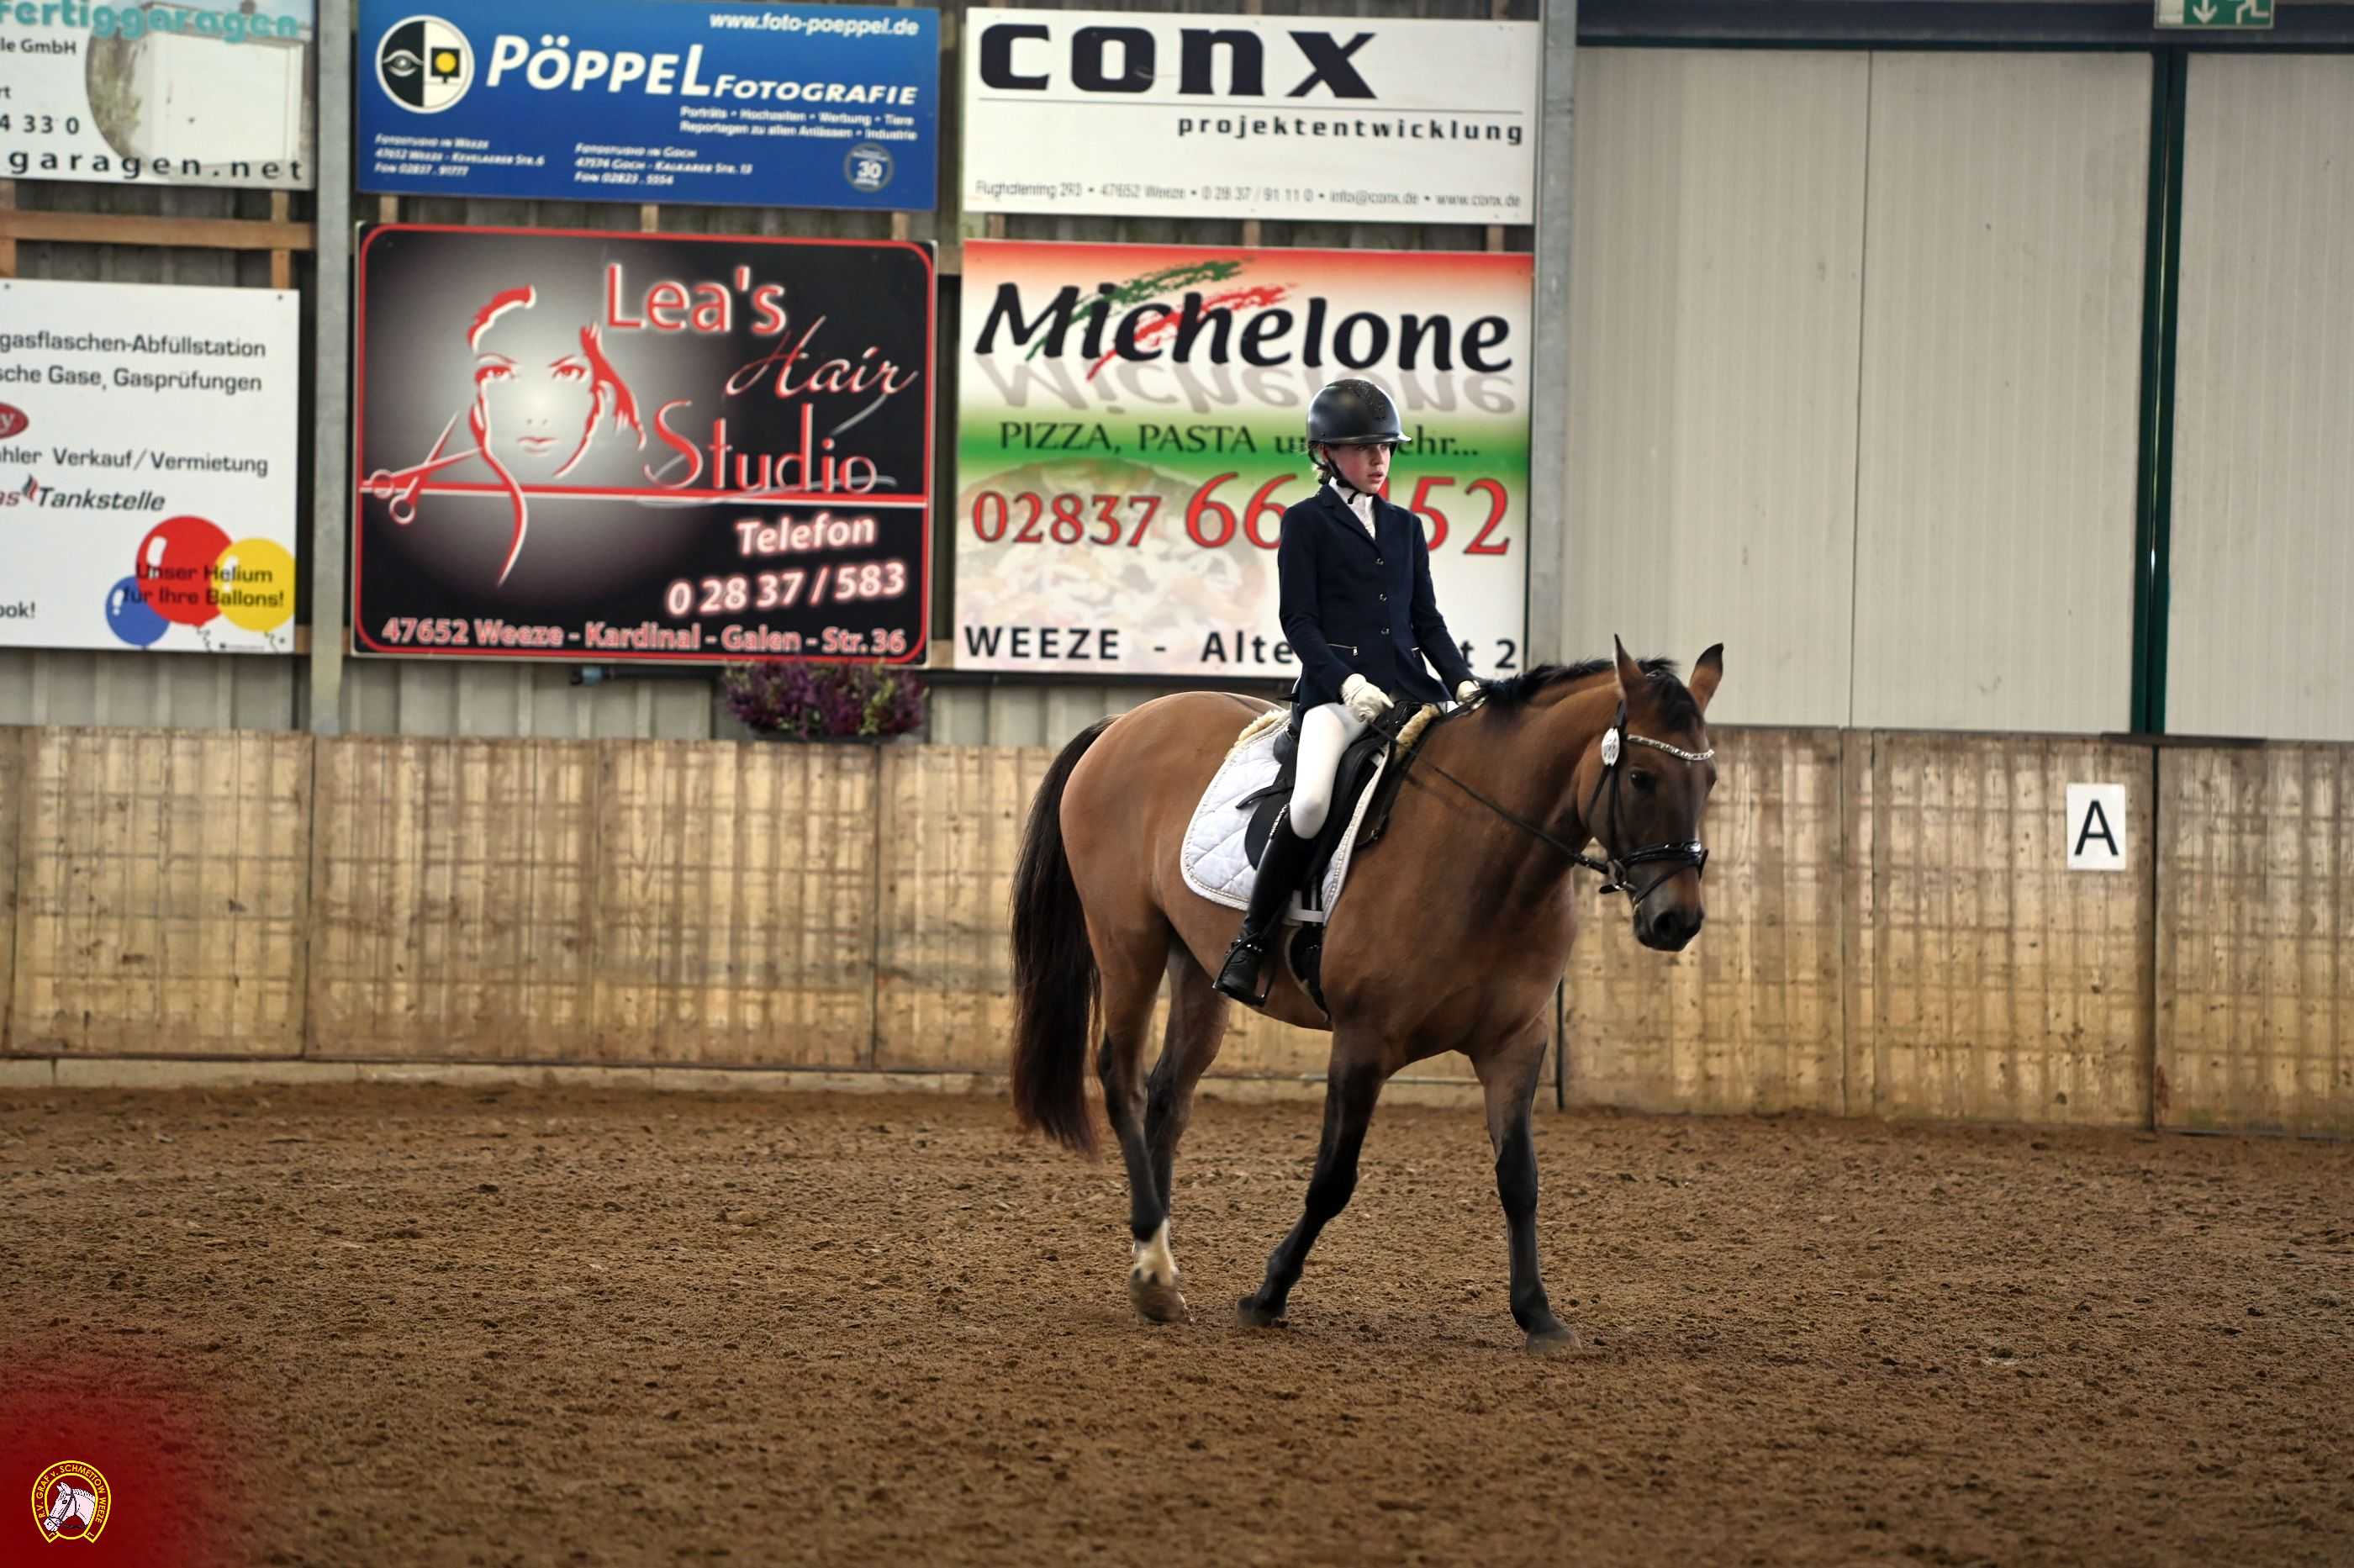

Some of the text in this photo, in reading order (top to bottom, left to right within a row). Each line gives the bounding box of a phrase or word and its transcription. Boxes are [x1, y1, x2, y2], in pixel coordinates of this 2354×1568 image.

[710, 12, 919, 38] www.foto-poeppel.de
[21, 39, 77, 55] GmbH
[979, 23, 1378, 99] conx
[486, 34, 918, 104] PÖPPEL FOTOGRAFIE
[1177, 114, 1523, 145] projektentwicklung
[858, 161, 882, 179] 30
[605, 262, 787, 335] Lea's
[974, 282, 1513, 372] Michelone
[725, 314, 919, 400] Hair
[48, 365, 107, 390] Gase,
[113, 367, 262, 395] Gasprüfungen
[0, 446, 42, 465] hler
[644, 399, 877, 494] Studio
[999, 420, 1122, 455] PIZZA,
[1137, 423, 1258, 455] PASTA
[1394, 425, 1479, 457] ehr...
[37, 486, 166, 512] Tankstelle
[972, 490, 1162, 548] 02837
[736, 514, 877, 556] Telefon
[136, 562, 272, 583] Unser Helium
[699, 575, 747, 612] 28
[758, 570, 804, 605] 37
[836, 562, 905, 599] 583
[159, 587, 198, 604] Ihre
[206, 589, 284, 608] Ballons!
[382, 617, 469, 645] 47652
[473, 619, 563, 647] Weeze
[584, 620, 700, 649] Kardinal
[720, 625, 801, 652] Galen
[821, 626, 867, 653] Str.
[871, 628, 906, 655] 36
[964, 626, 1121, 661] WEEZE
[1495, 639, 1517, 668] 2
[2074, 800, 2119, 856] A
